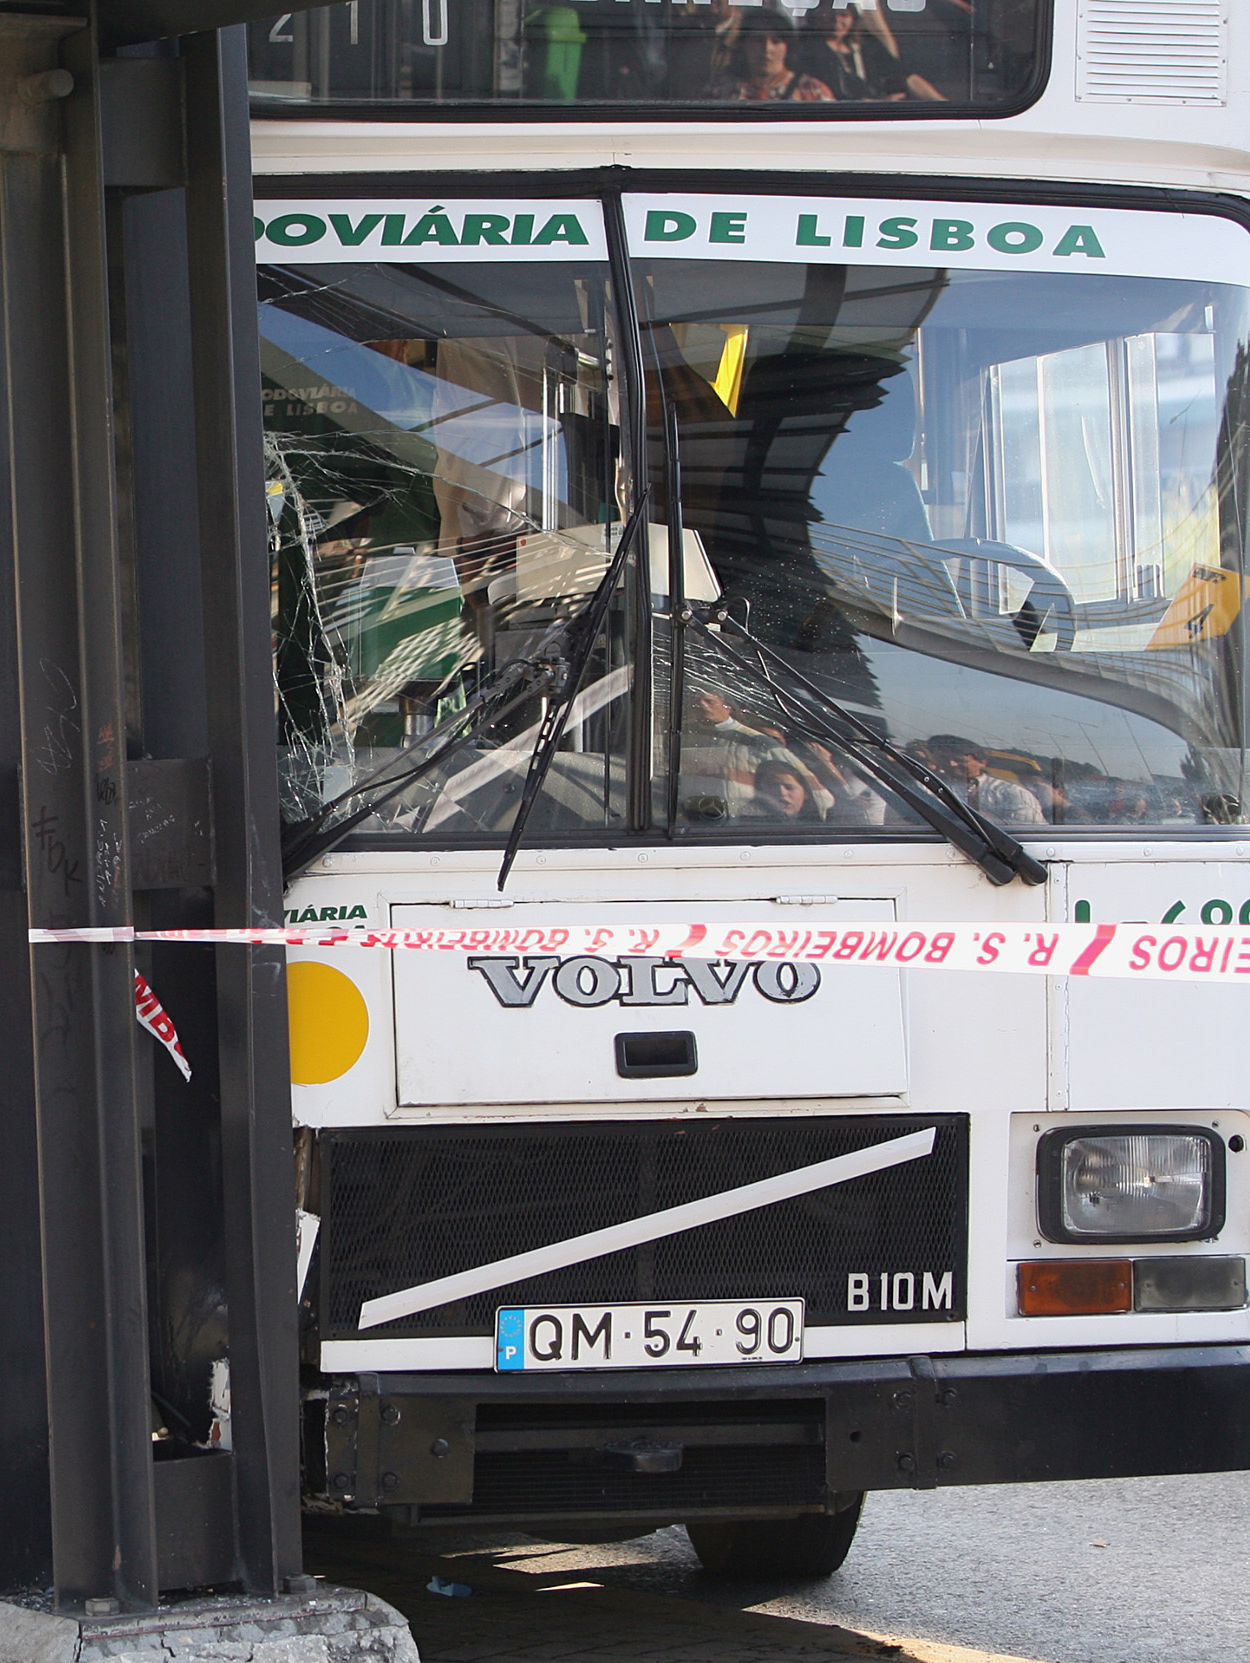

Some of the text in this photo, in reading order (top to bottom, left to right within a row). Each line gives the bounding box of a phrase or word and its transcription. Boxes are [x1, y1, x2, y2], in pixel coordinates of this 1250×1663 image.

[253, 204, 1107, 258] OVIÁRIA DE LISBOA
[714, 930, 956, 963] BOMBEIROS
[973, 932, 1006, 965] S.
[1023, 933, 1059, 966] R.
[467, 955, 821, 1008] VOLVO
[505, 1346, 517, 1359] P
